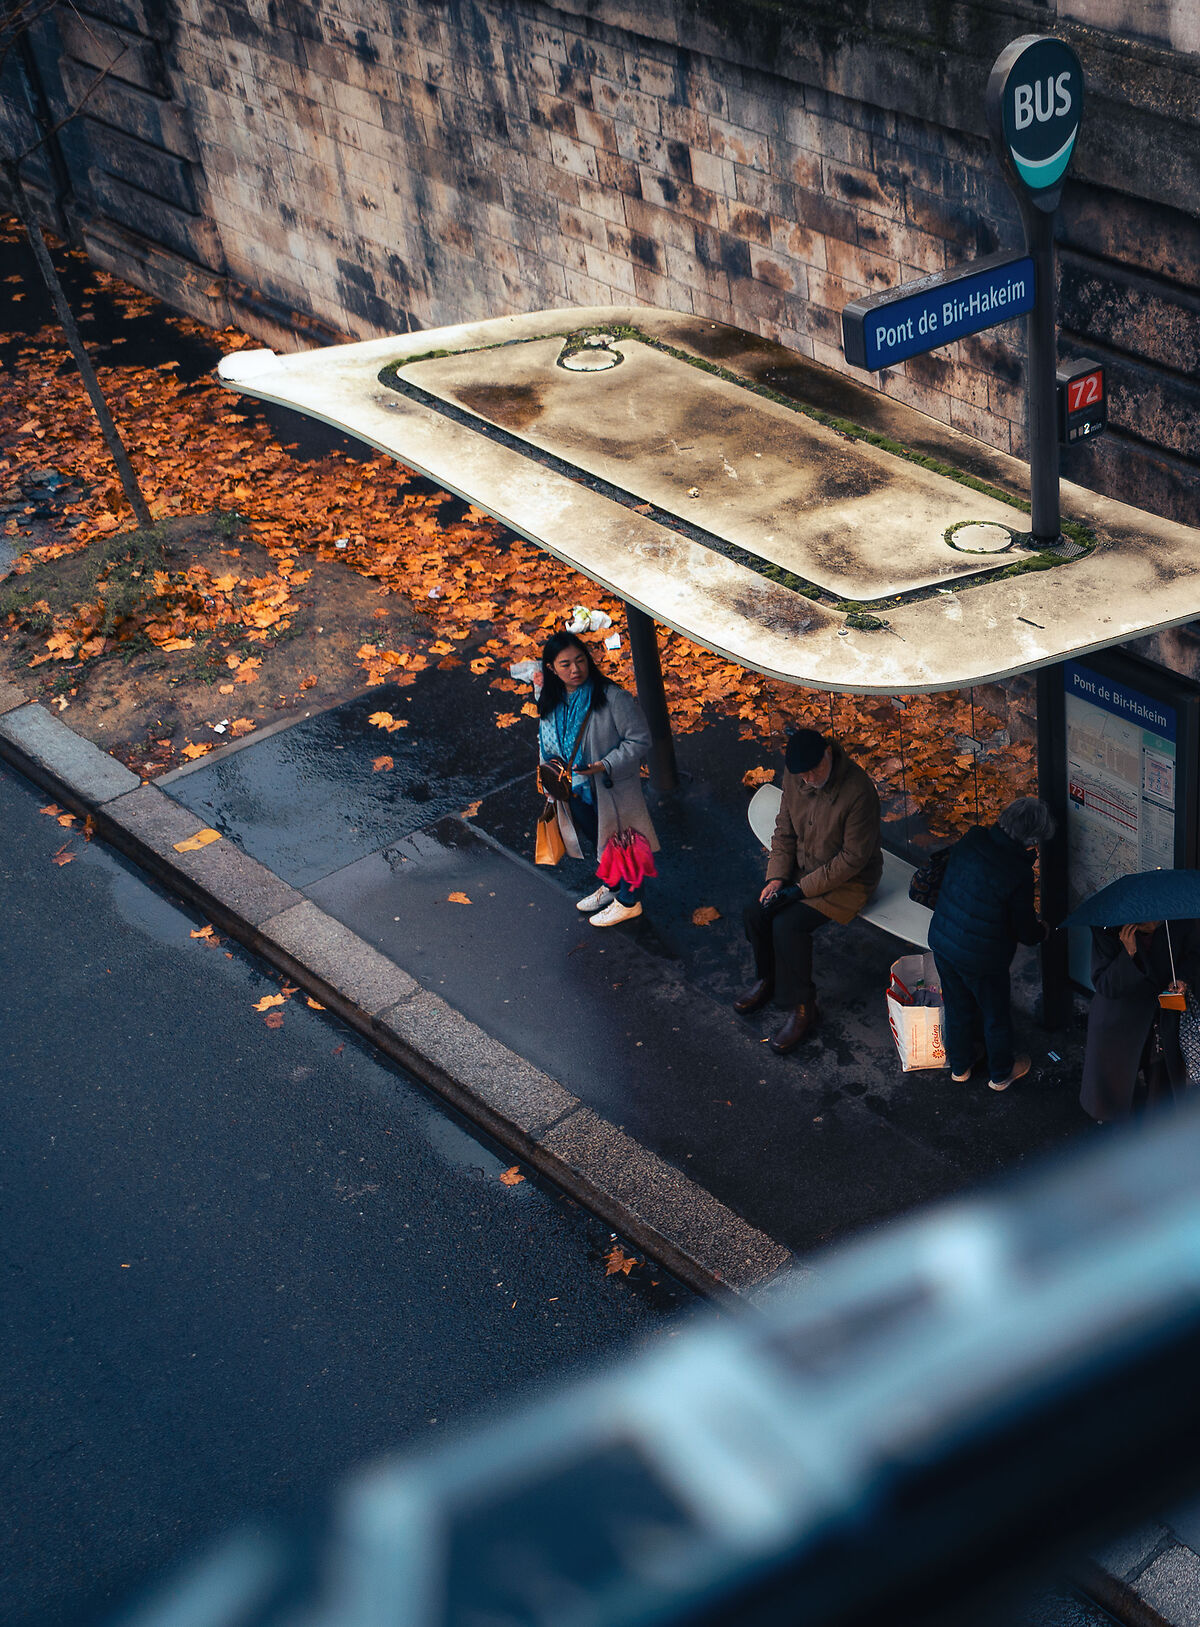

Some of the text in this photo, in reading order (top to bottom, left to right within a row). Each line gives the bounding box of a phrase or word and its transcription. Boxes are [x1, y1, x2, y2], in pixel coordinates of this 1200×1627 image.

[1014, 71, 1072, 131] BUS
[876, 279, 1026, 351] Pont de Bir-Hakeim
[1072, 376, 1098, 409] 72
[1083, 422, 1090, 435] 2
[1073, 673, 1167, 727] Pont de Bir-Hakeim
[1071, 784, 1083, 799] 72
[931, 1024, 941, 1049] Casino
